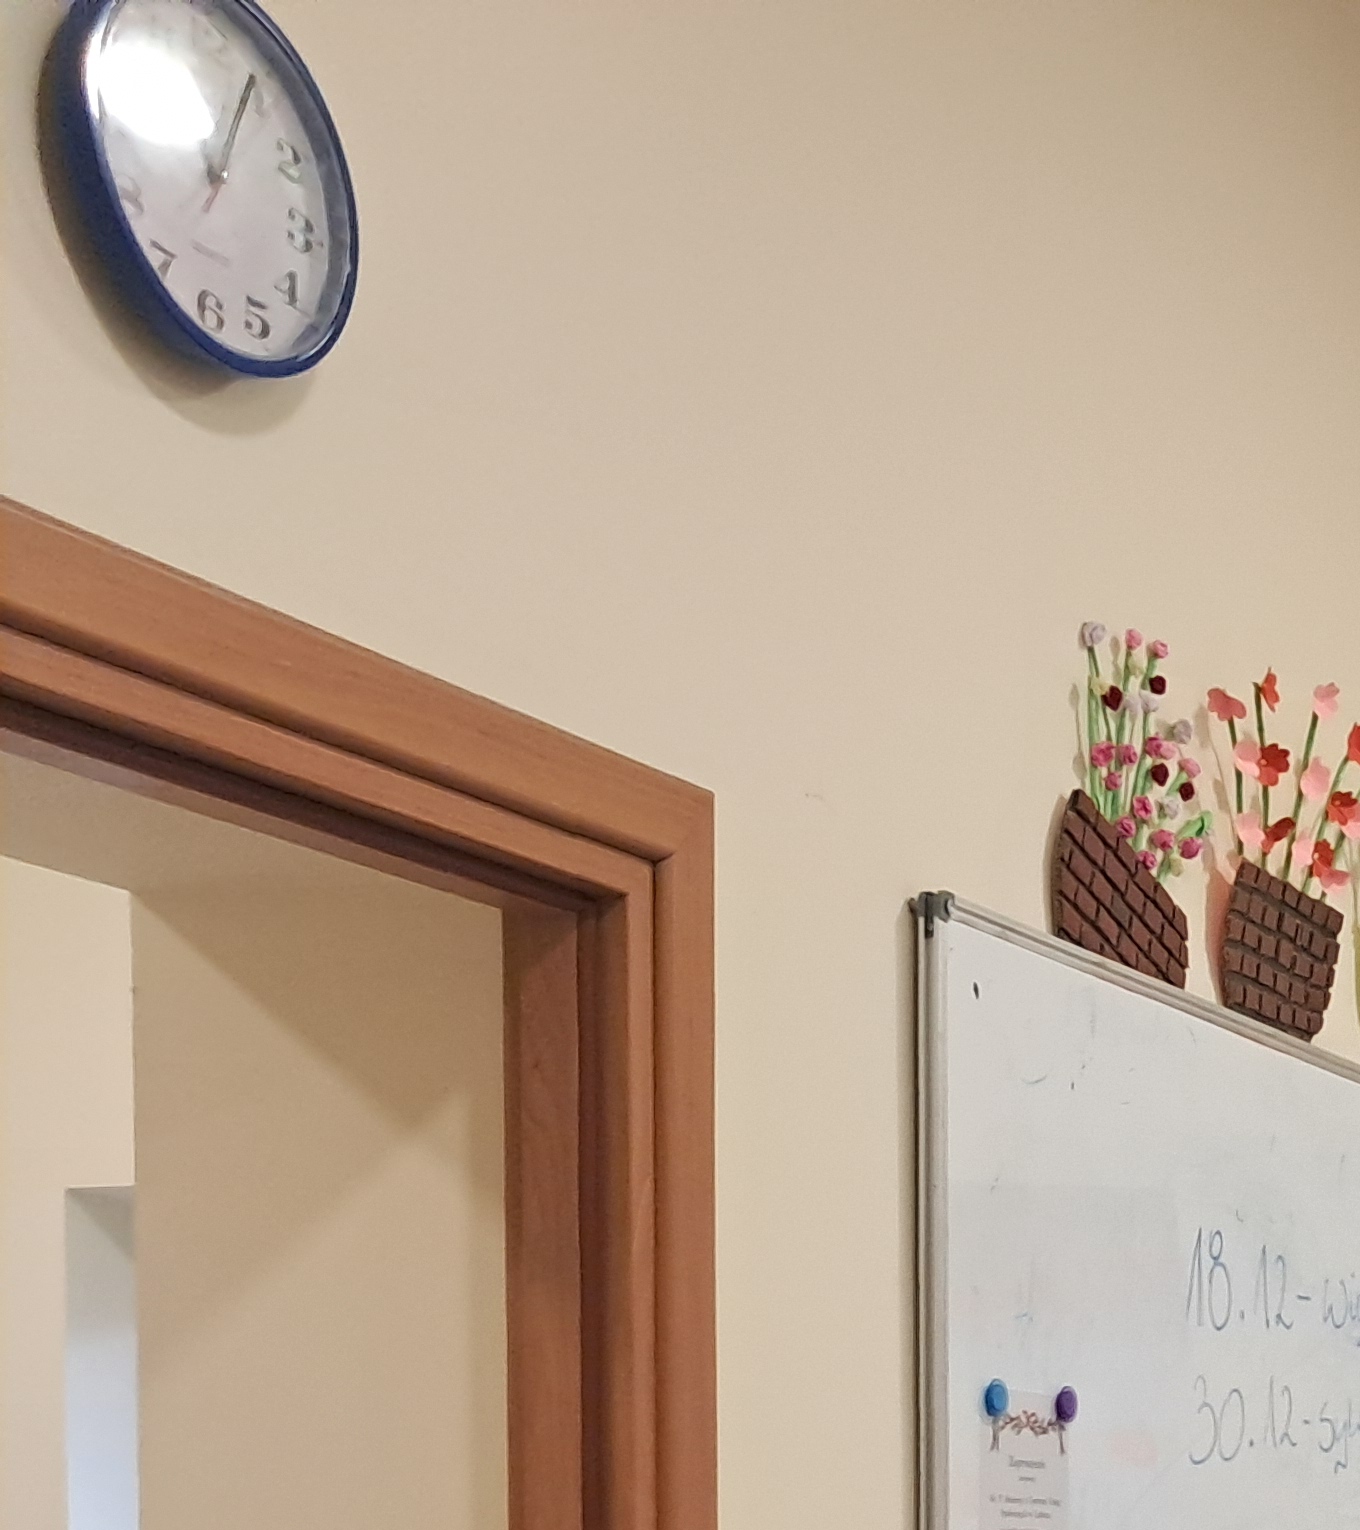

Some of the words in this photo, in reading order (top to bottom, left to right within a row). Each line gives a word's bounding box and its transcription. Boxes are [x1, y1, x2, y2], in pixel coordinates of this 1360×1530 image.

[276, 138, 302, 184] 2
[287, 207, 314, 254] 3
[149, 239, 178, 278] 7
[197, 288, 225, 333] 6
[274, 270, 300, 307] 4
[243, 294, 271, 341] 5
